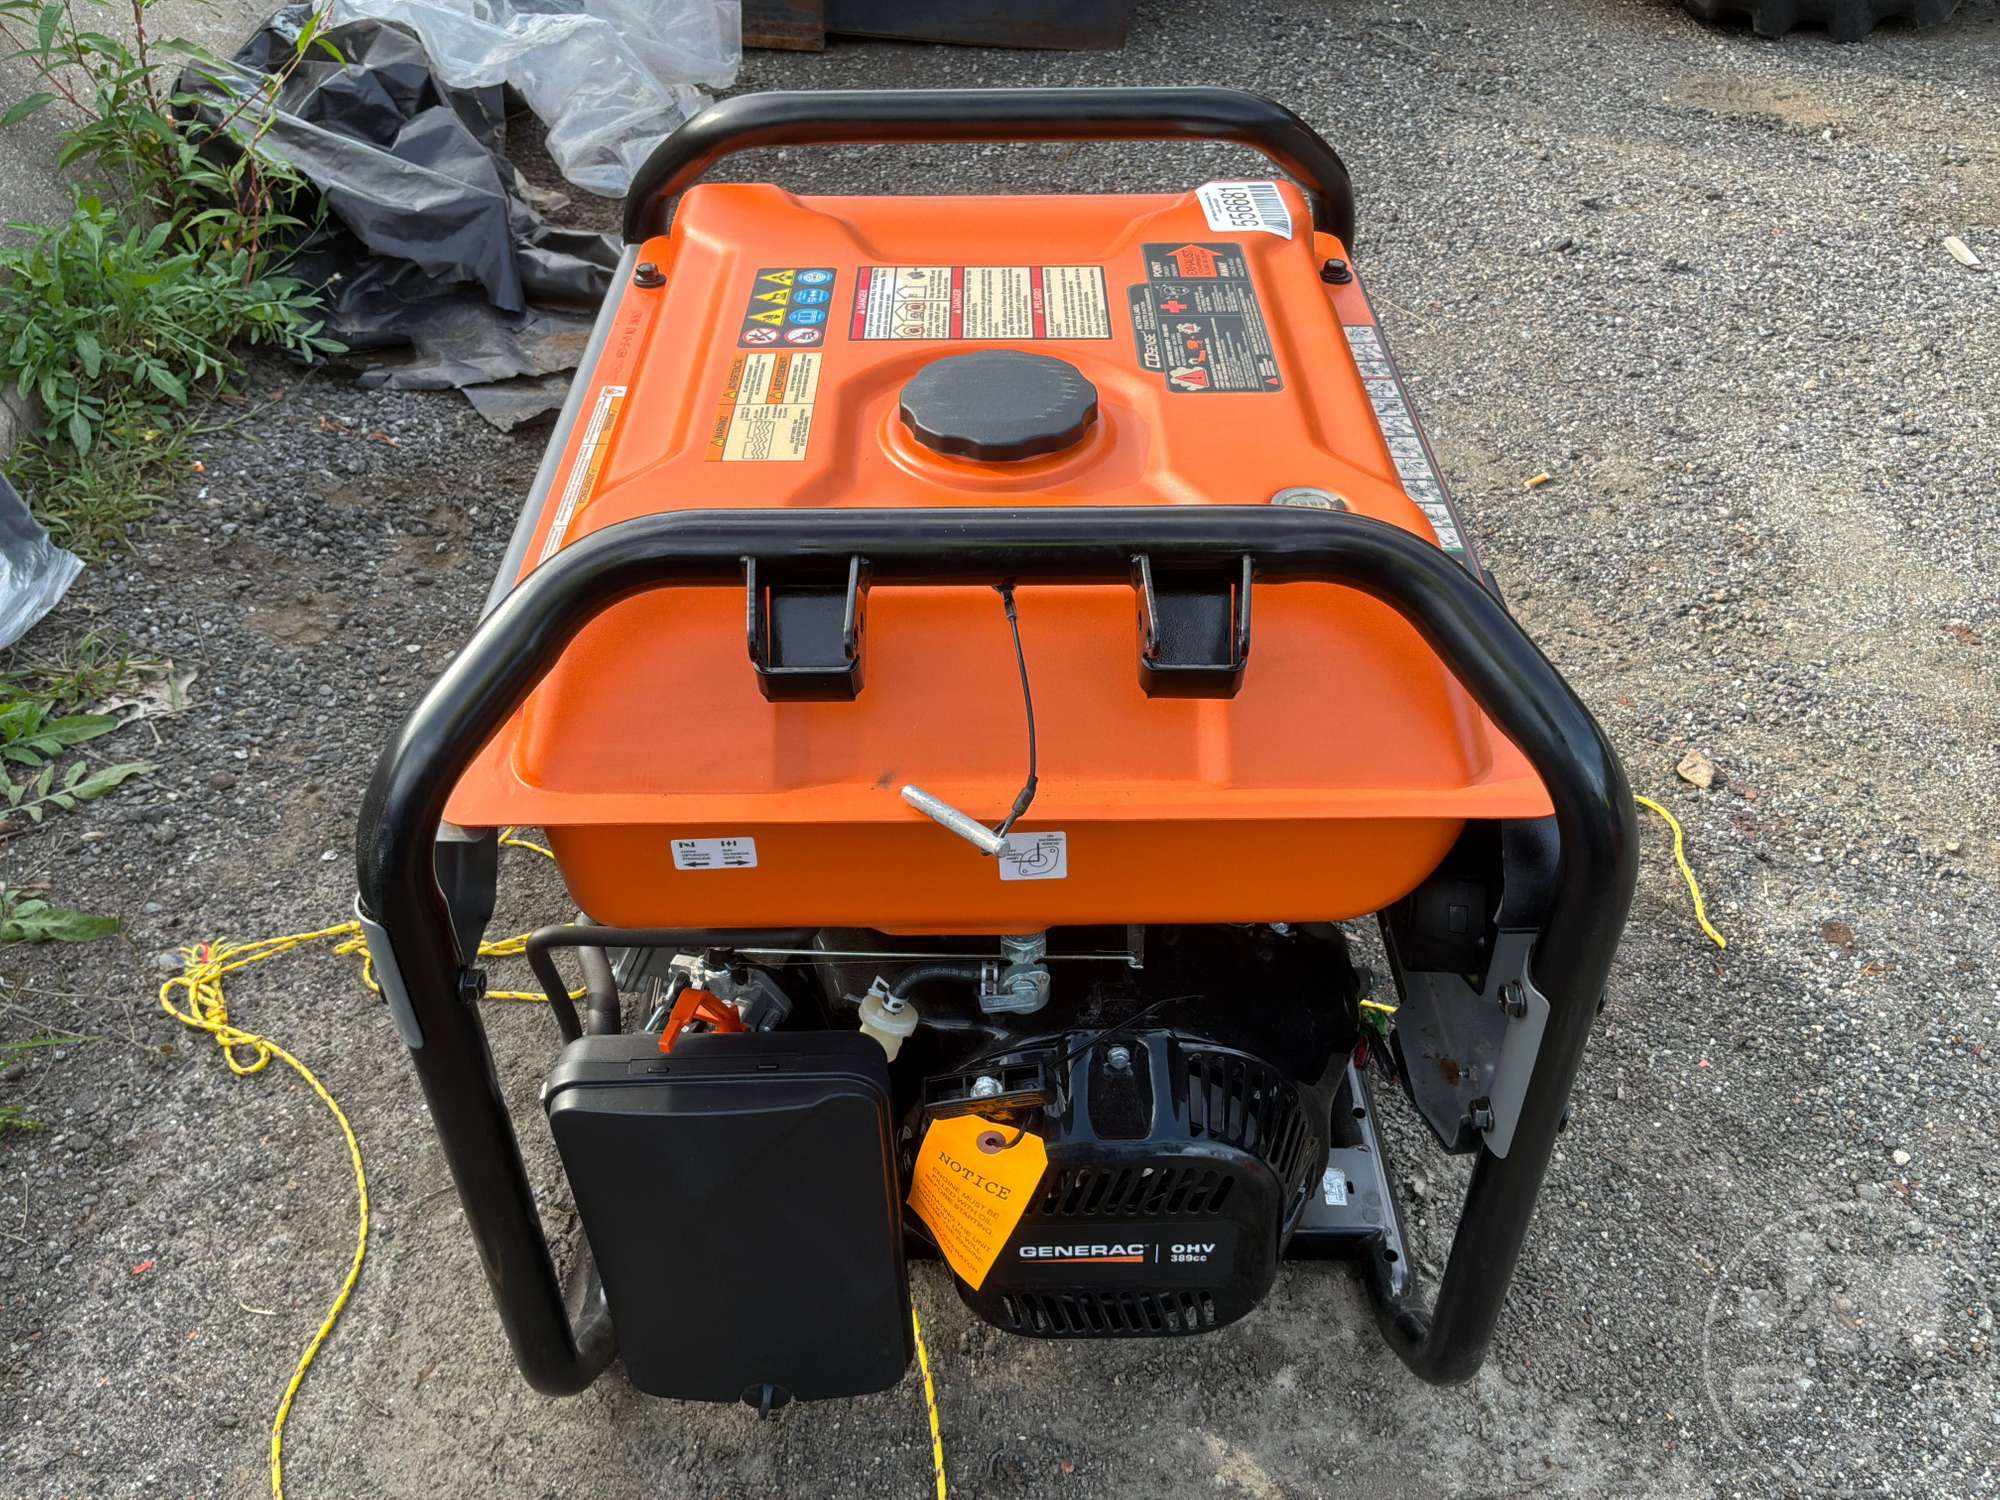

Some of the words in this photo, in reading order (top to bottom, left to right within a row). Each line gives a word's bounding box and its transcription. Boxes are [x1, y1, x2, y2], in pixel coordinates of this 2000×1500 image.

[1219, 187, 1259, 227] 556681
[1151, 260, 1163, 277] POINT
[1183, 249, 1197, 275] EXHAUST
[856, 289, 868, 310] DANGER
[952, 288, 962, 309] DANGER
[1033, 287, 1043, 309] PELIGRO
[938, 1152, 1011, 1200] NOTICE
[933, 1167, 960, 1192] ENGINE
[962, 1193, 984, 1210] MUST
[987, 1208, 1000, 1219] BE
[957, 1197, 977, 1214] WITH
[1019, 1244, 1144, 1257] GENERAC
[1170, 1243, 1216, 1253] OHV
[1170, 1254, 1207, 1262] 389cc
